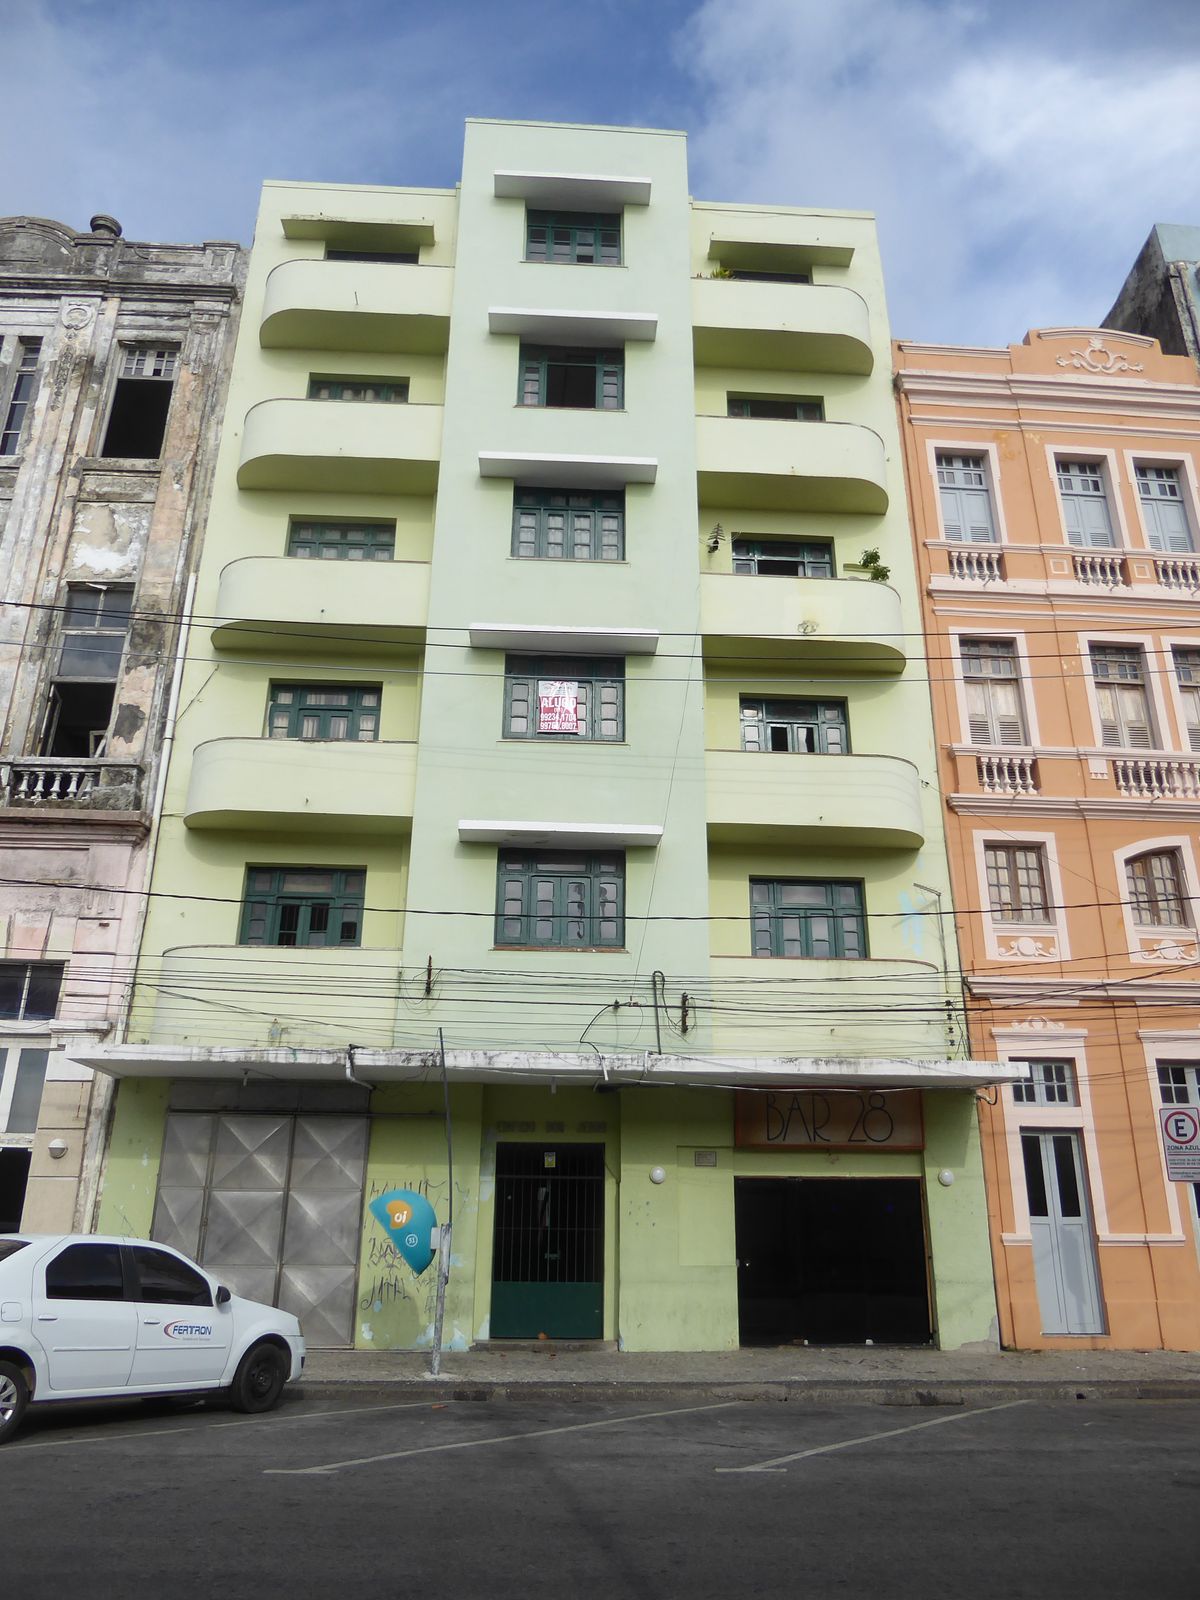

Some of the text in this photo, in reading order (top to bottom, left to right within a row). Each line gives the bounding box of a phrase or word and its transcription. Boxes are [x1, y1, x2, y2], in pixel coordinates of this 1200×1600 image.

[766, 1093, 894, 1142] BAR 28
[1174, 1118, 1188, 1137] E
[172, 1325, 212, 1335] FERTRON
